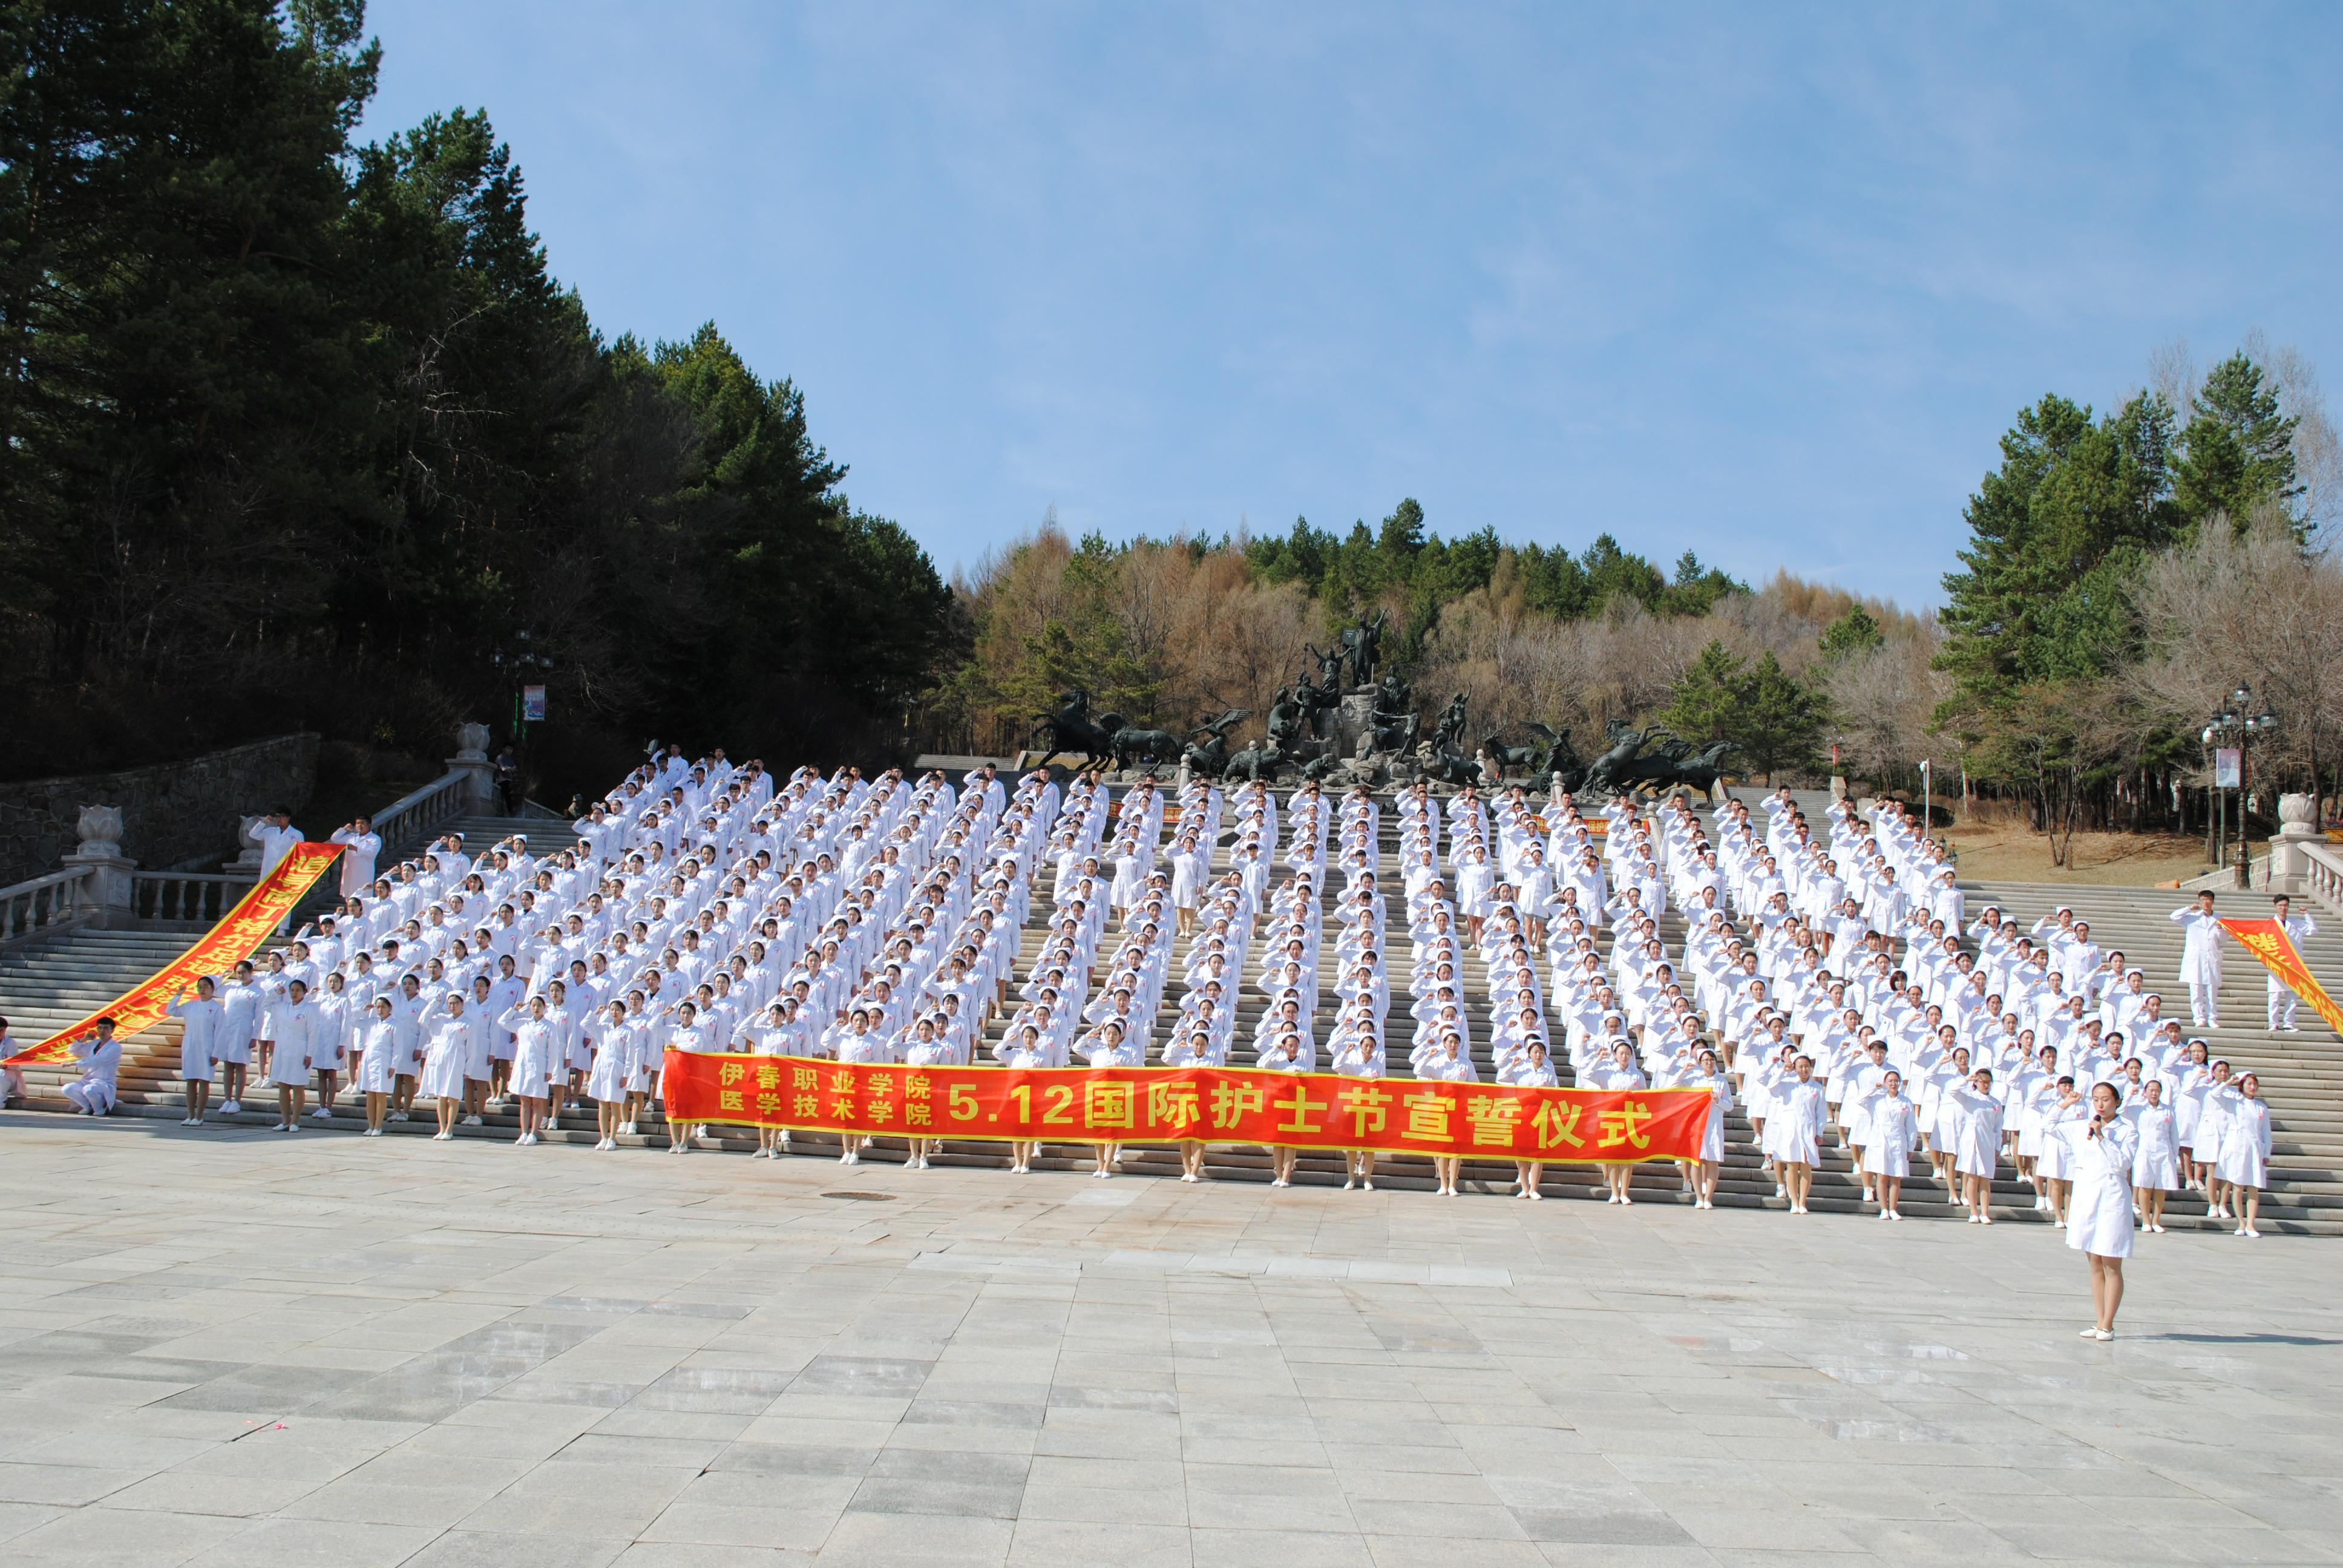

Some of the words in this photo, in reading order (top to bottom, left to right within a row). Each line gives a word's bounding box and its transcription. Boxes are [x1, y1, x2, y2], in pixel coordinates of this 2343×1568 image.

[719, 1062, 931, 1099] 伊春职业学院
[720, 1091, 932, 1126] 医学技术学院
